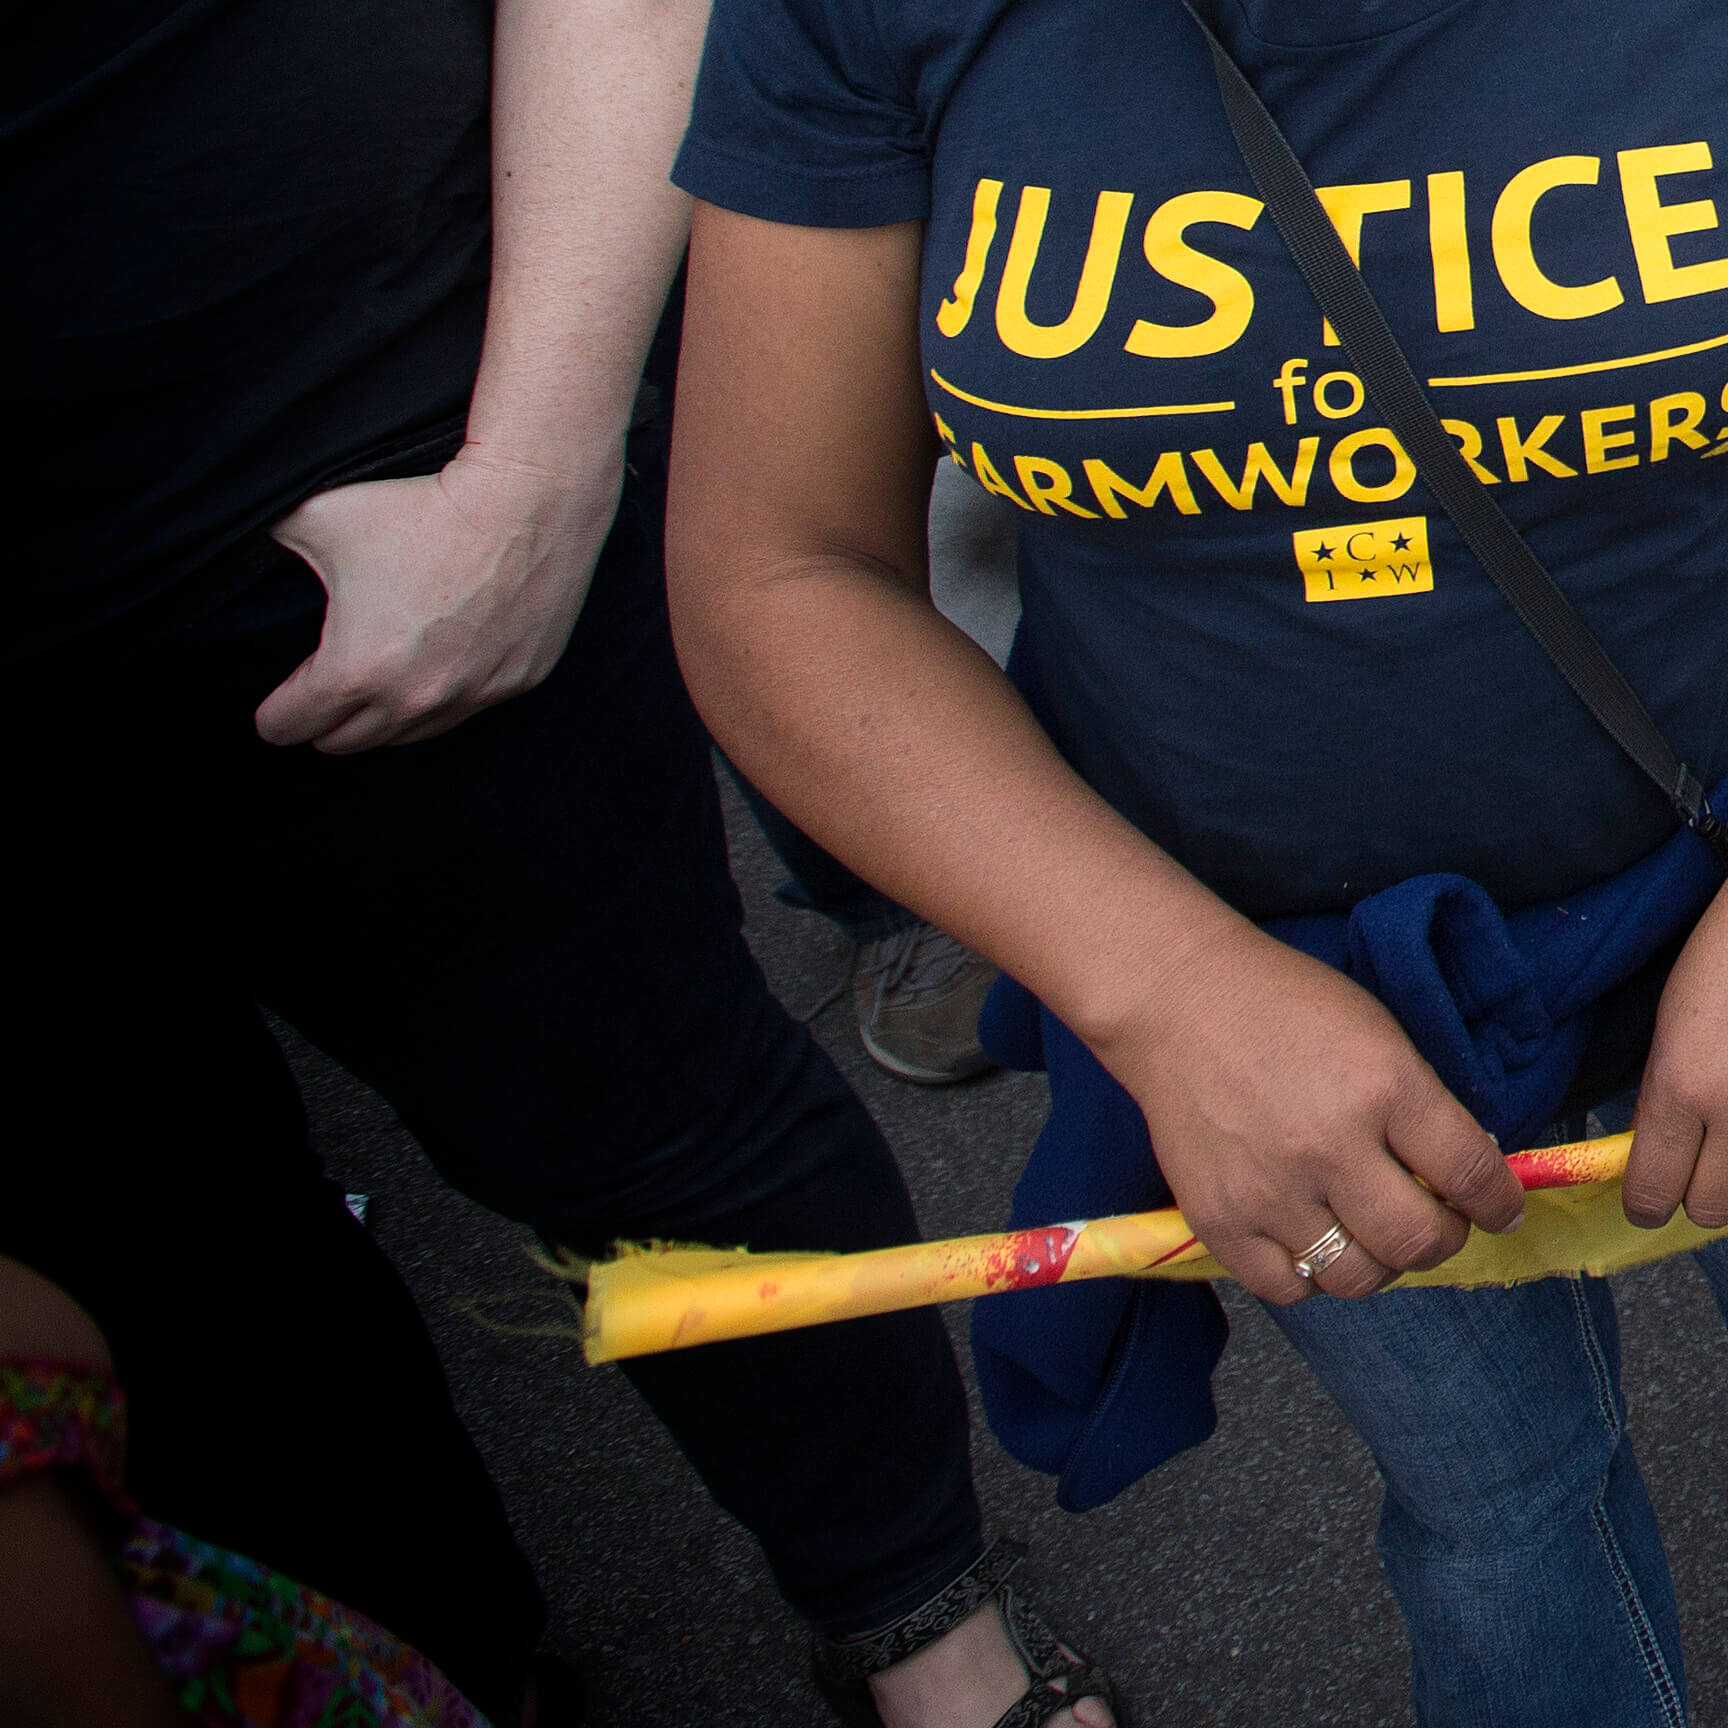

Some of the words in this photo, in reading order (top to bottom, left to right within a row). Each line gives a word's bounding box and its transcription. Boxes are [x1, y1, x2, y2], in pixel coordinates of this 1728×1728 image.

[1273, 358, 1366, 426] fo
[1346, 532, 1377, 562] C
[1326, 569, 1335, 592] I
[1386, 562, 1420, 584] W
